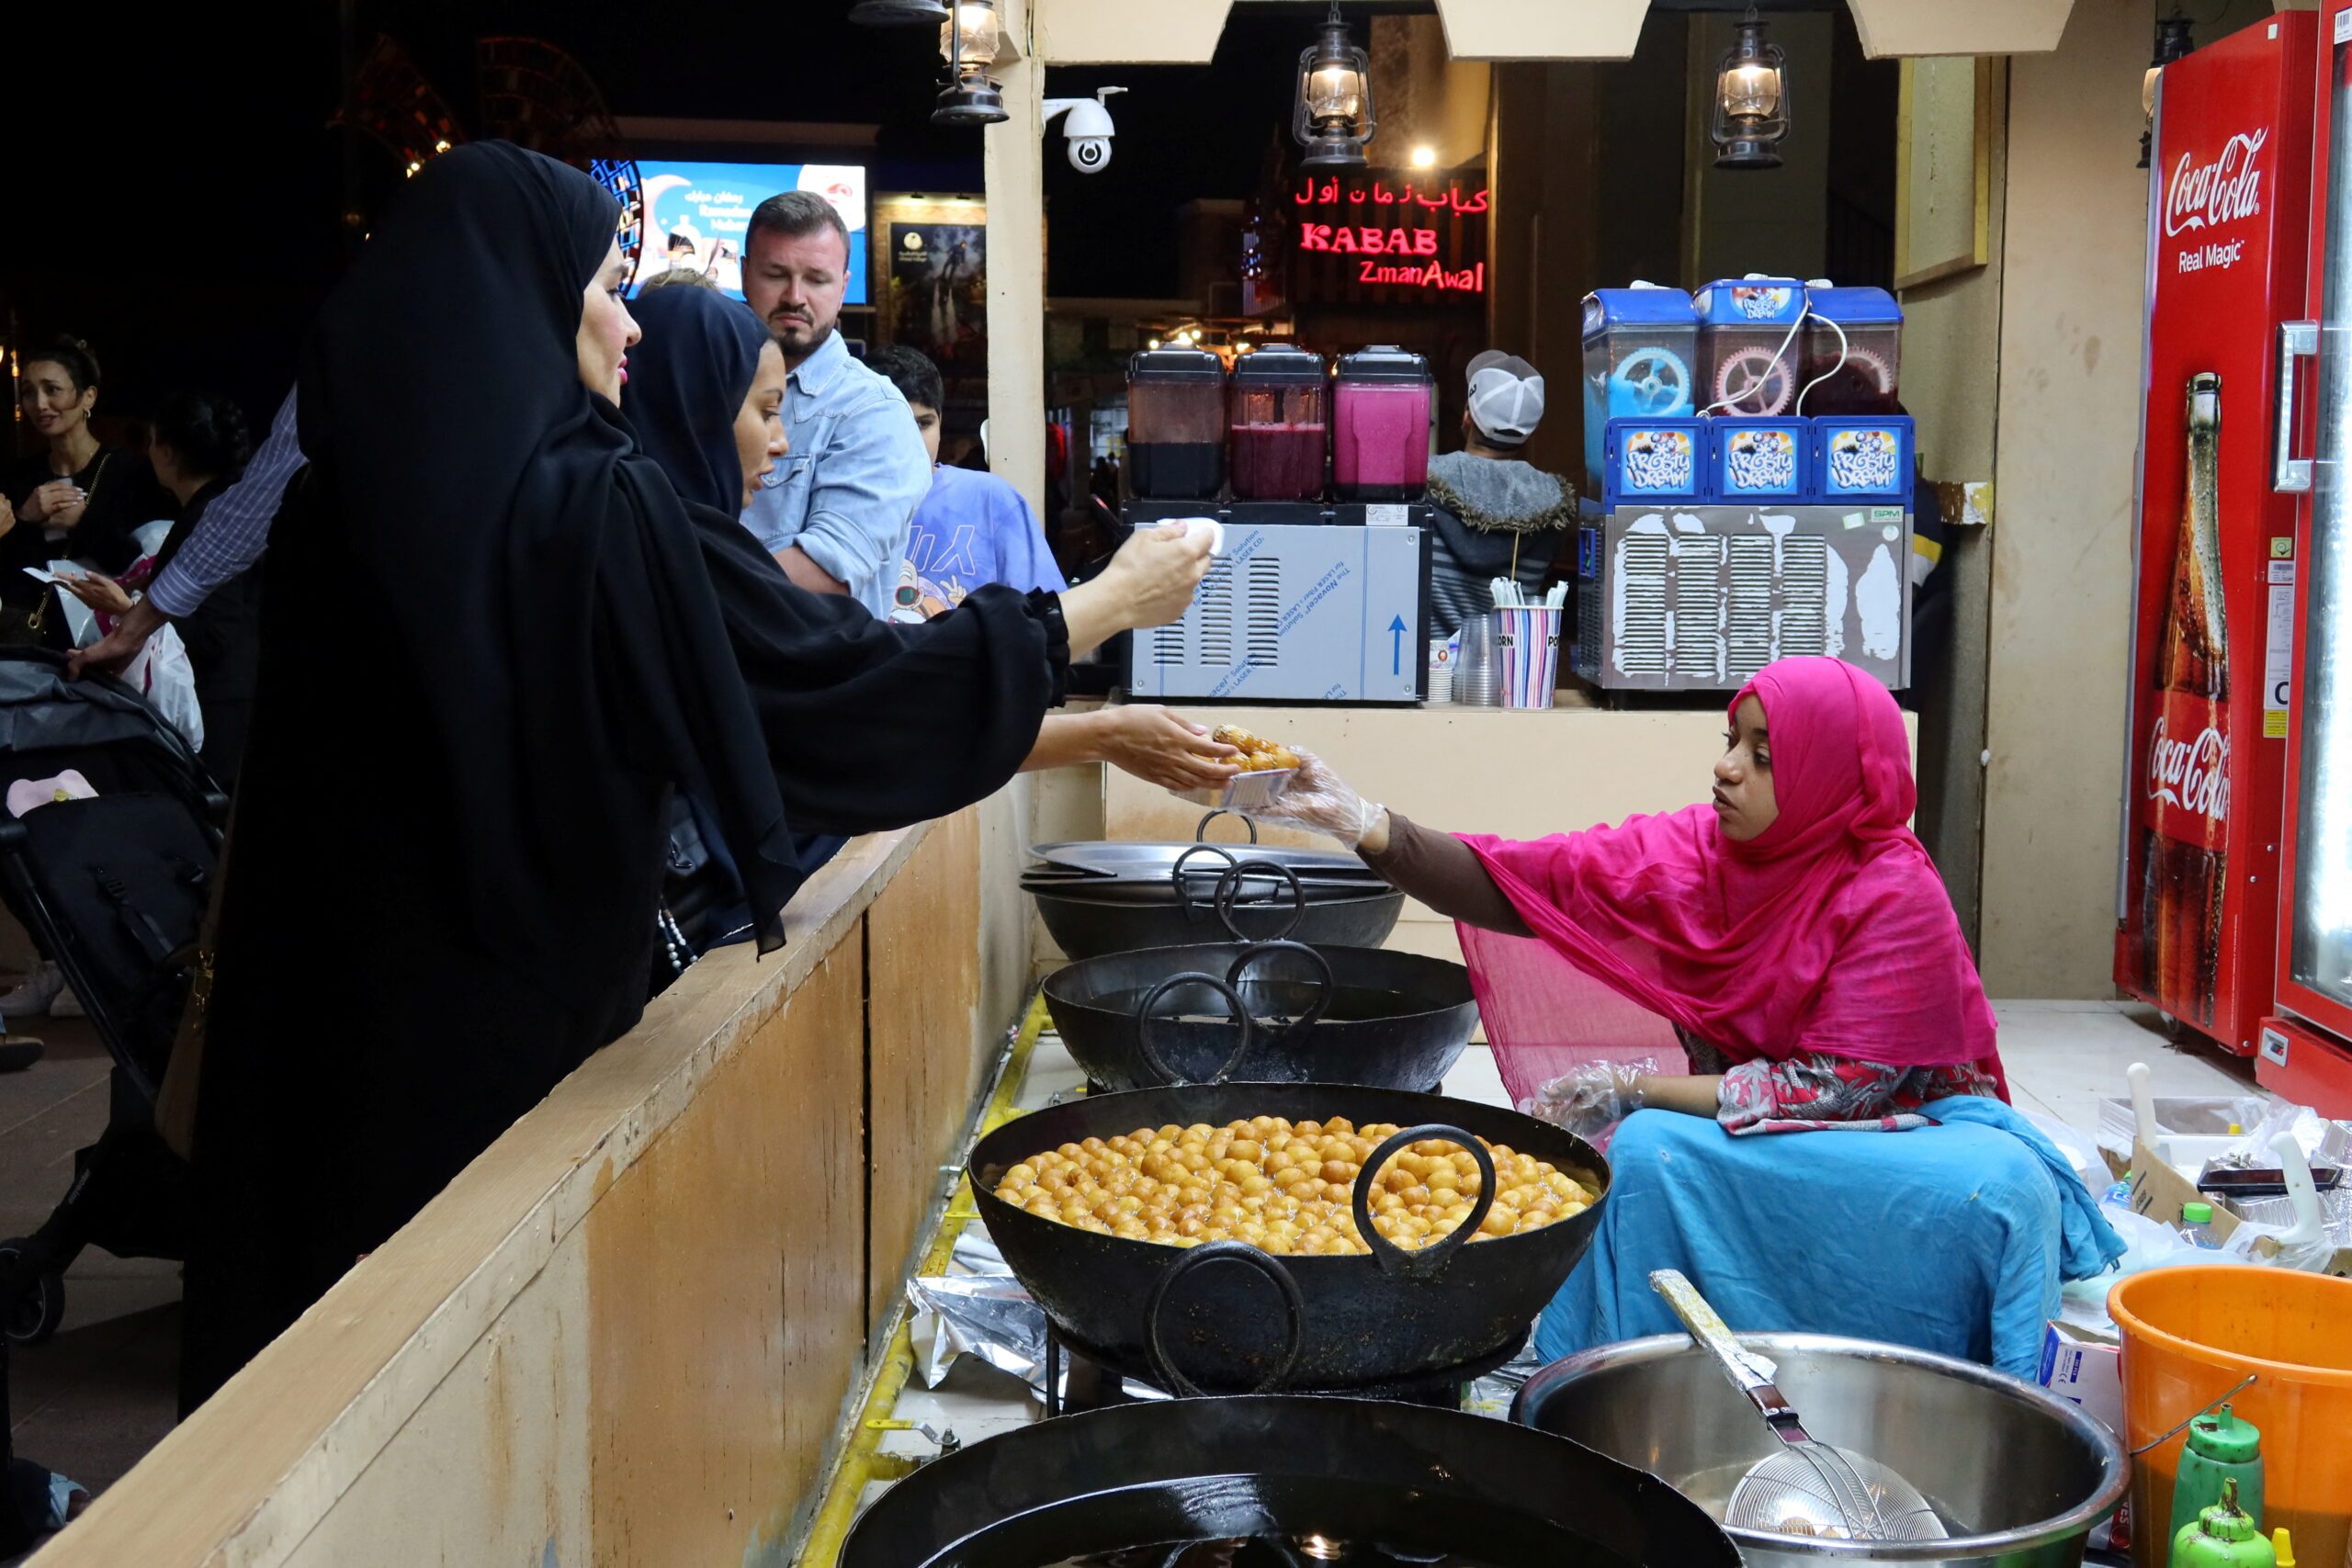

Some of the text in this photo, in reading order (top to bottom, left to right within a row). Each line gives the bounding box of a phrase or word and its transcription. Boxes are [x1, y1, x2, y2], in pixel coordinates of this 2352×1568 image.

[1295, 175, 1340, 205] أول
[2165, 125, 2268, 237] Coca-Cola
[1416, 186, 1489, 217] كباب
[1300, 222, 1439, 255] KABAB
[2178, 246, 2203, 274] Real
[1633, 469, 1685, 489] DREAM
[1736, 469, 1788, 489] DREAM
[1838, 468, 1890, 488] DREAM
[1873, 510, 1900, 519] SPM
[1236, 546, 1253, 565] LASER
[1317, 569, 1336, 588] LASER
[1337, 568, 1351, 581] The
[2147, 716, 2230, 821] Coca-Cola
